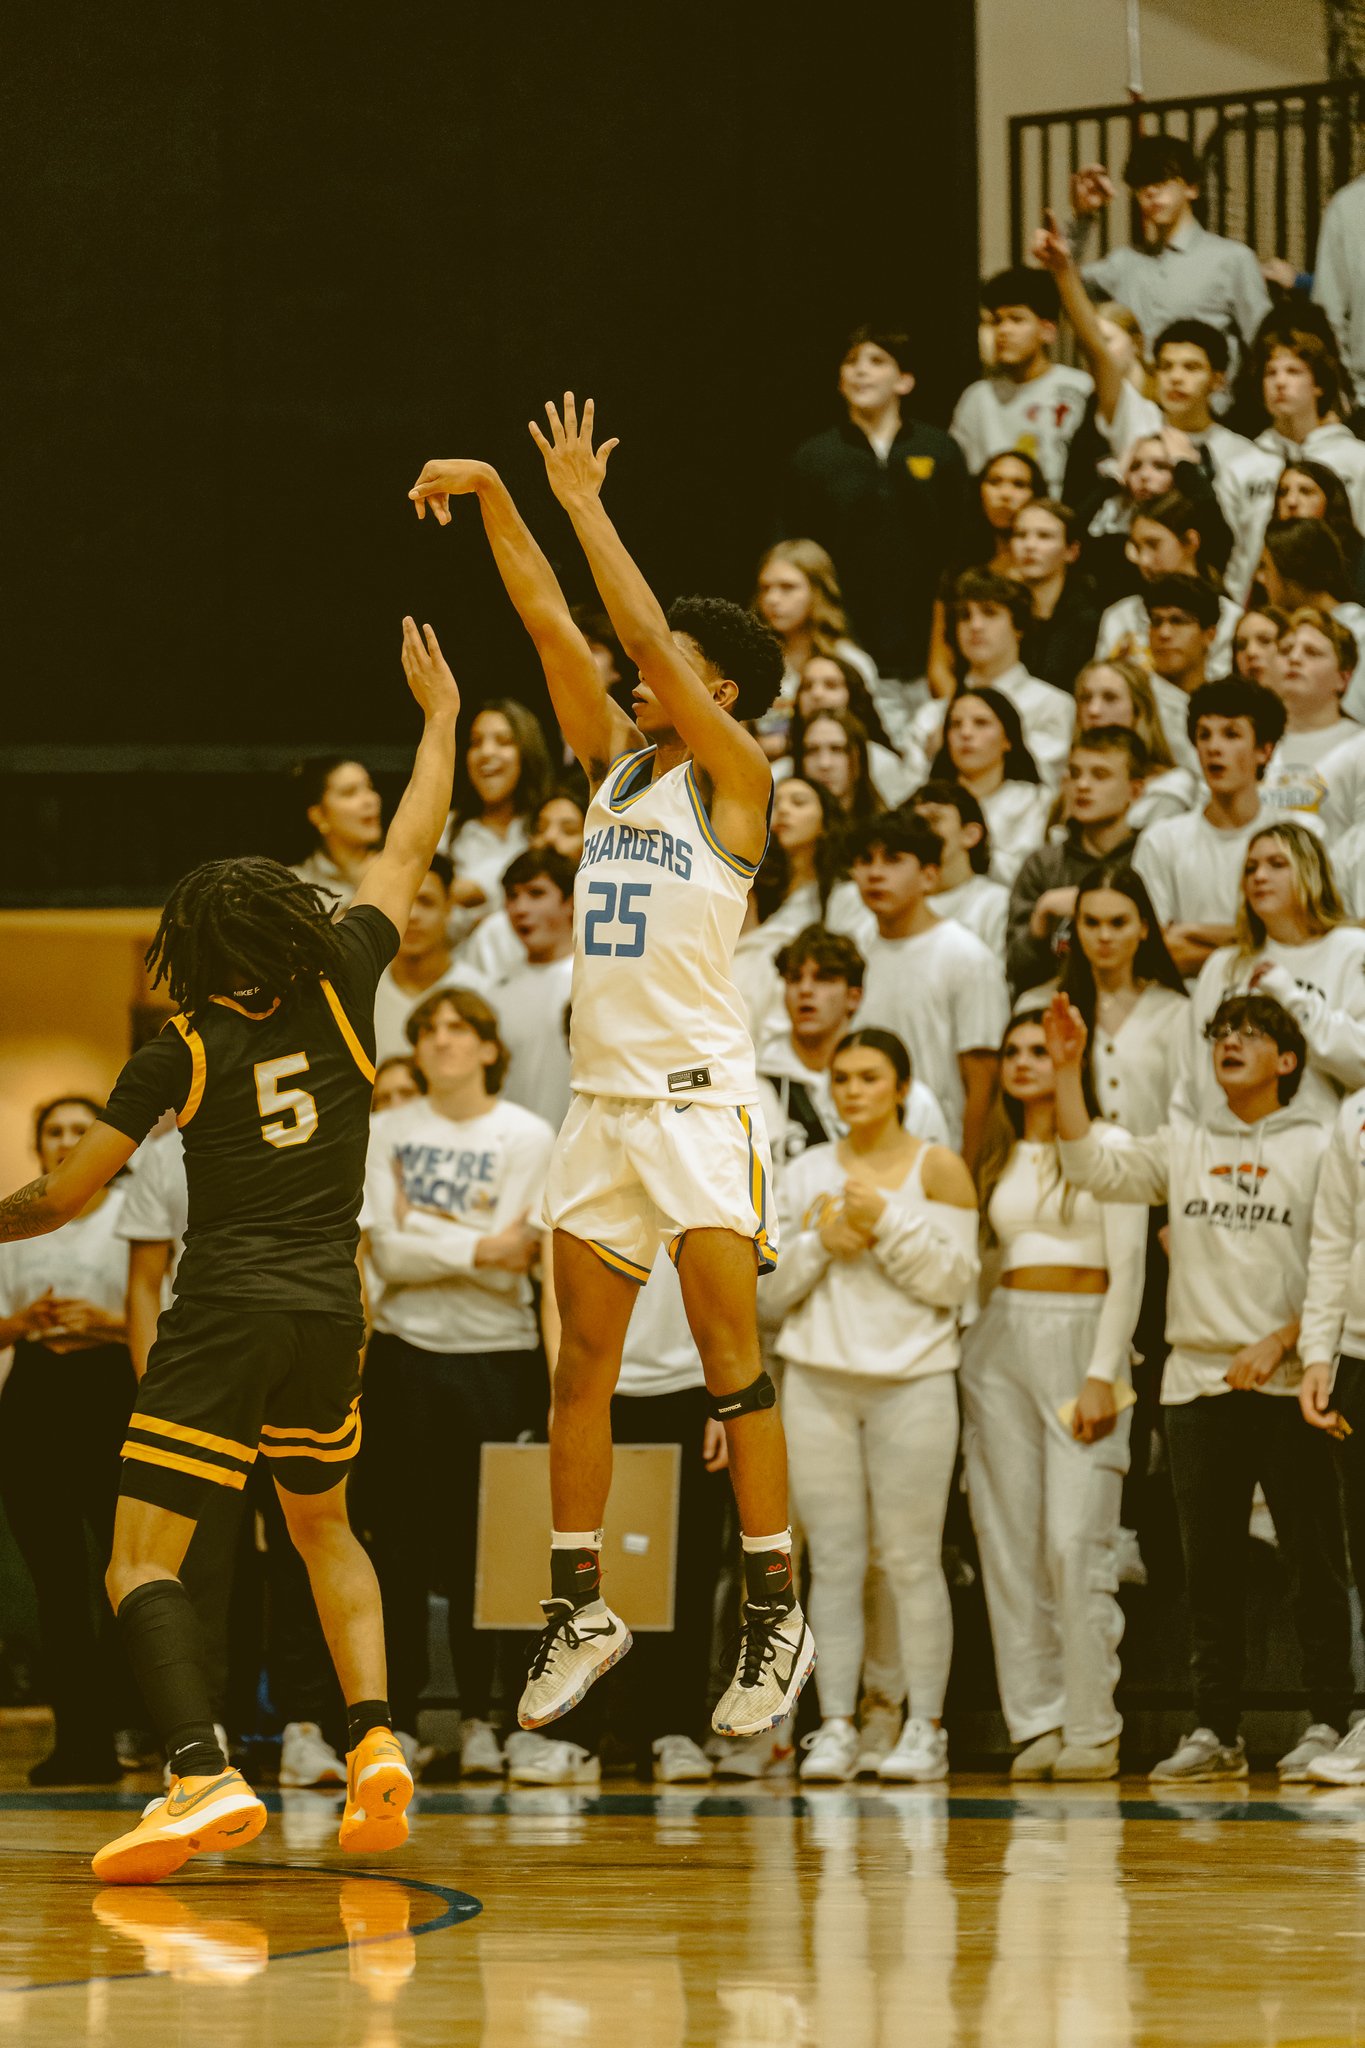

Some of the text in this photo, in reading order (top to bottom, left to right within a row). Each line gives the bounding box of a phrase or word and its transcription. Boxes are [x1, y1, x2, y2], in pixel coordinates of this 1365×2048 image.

[576, 825, 693, 881] CHARGERS
[585, 881, 652, 958] 25
[233, 988, 254, 997] NIKE
[253, 1051, 319, 1149] 5
[697, 1074, 704, 1083] S
[403, 1175, 470, 1213] ACK
